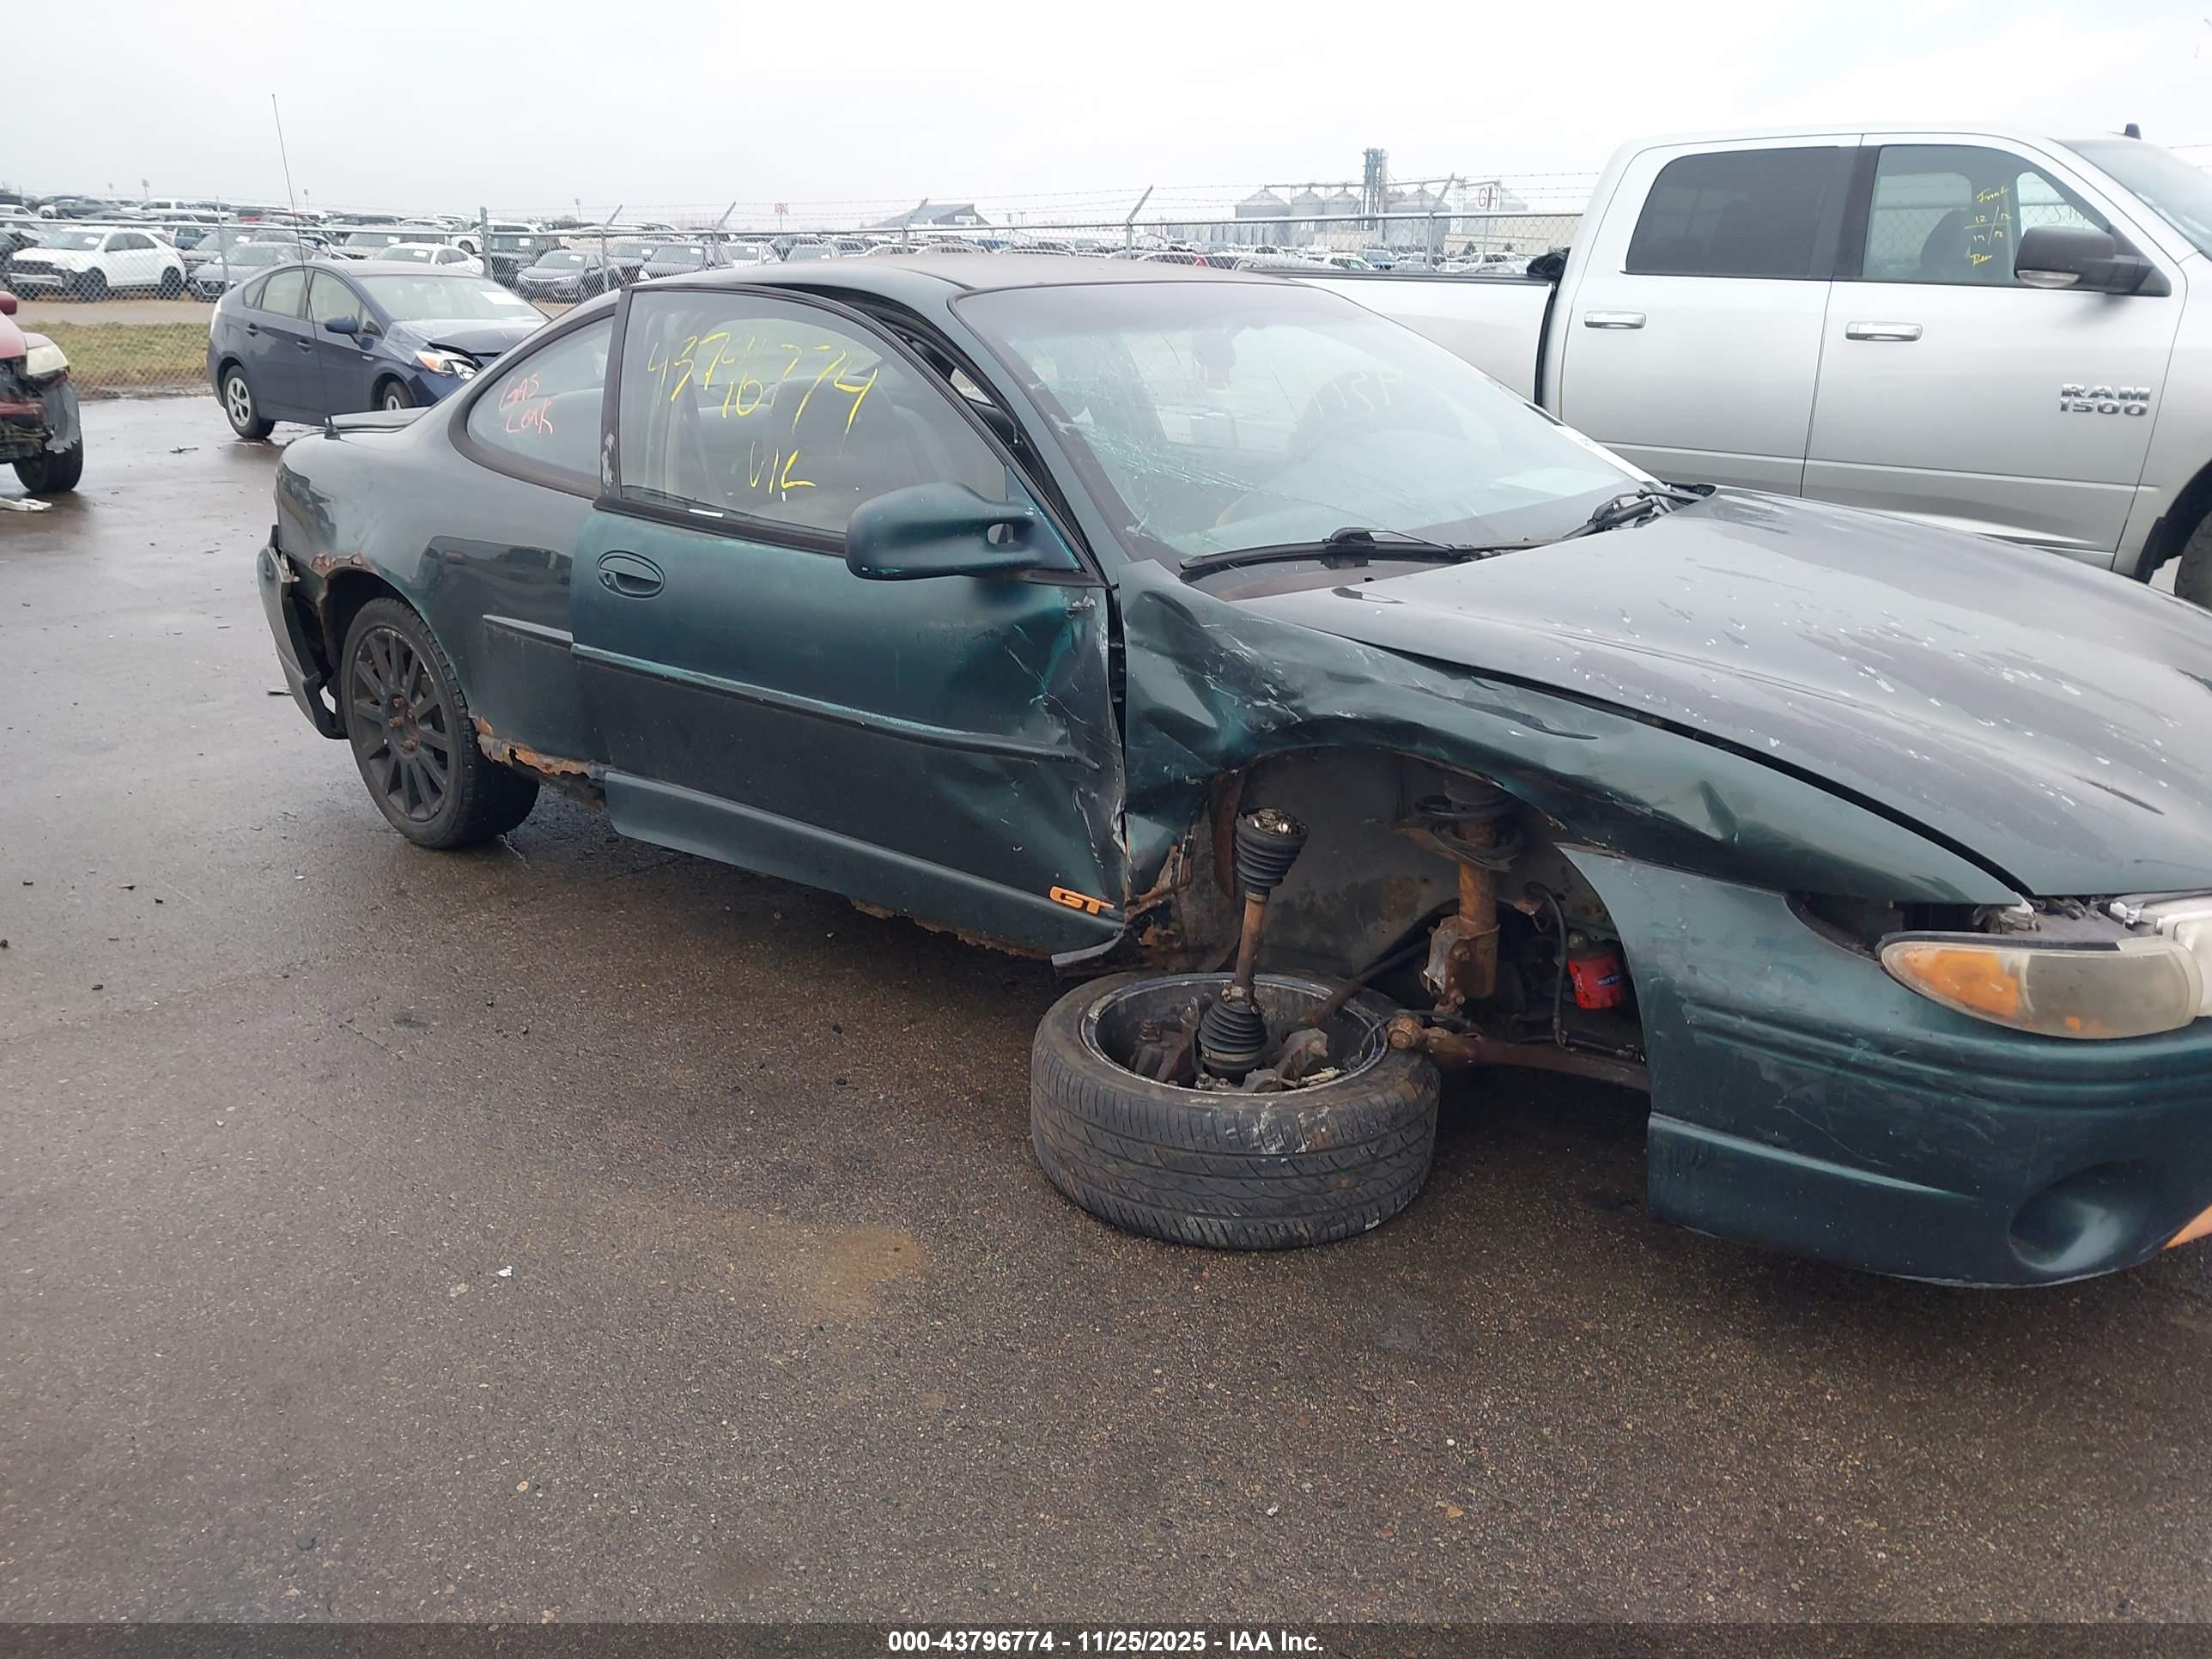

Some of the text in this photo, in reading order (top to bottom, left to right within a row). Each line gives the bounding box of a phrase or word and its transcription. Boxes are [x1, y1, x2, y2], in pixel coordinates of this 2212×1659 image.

[2061, 383, 2151, 401] RAM
[2060, 398, 2148, 416] 1500
[1049, 885, 1115, 915] GT
